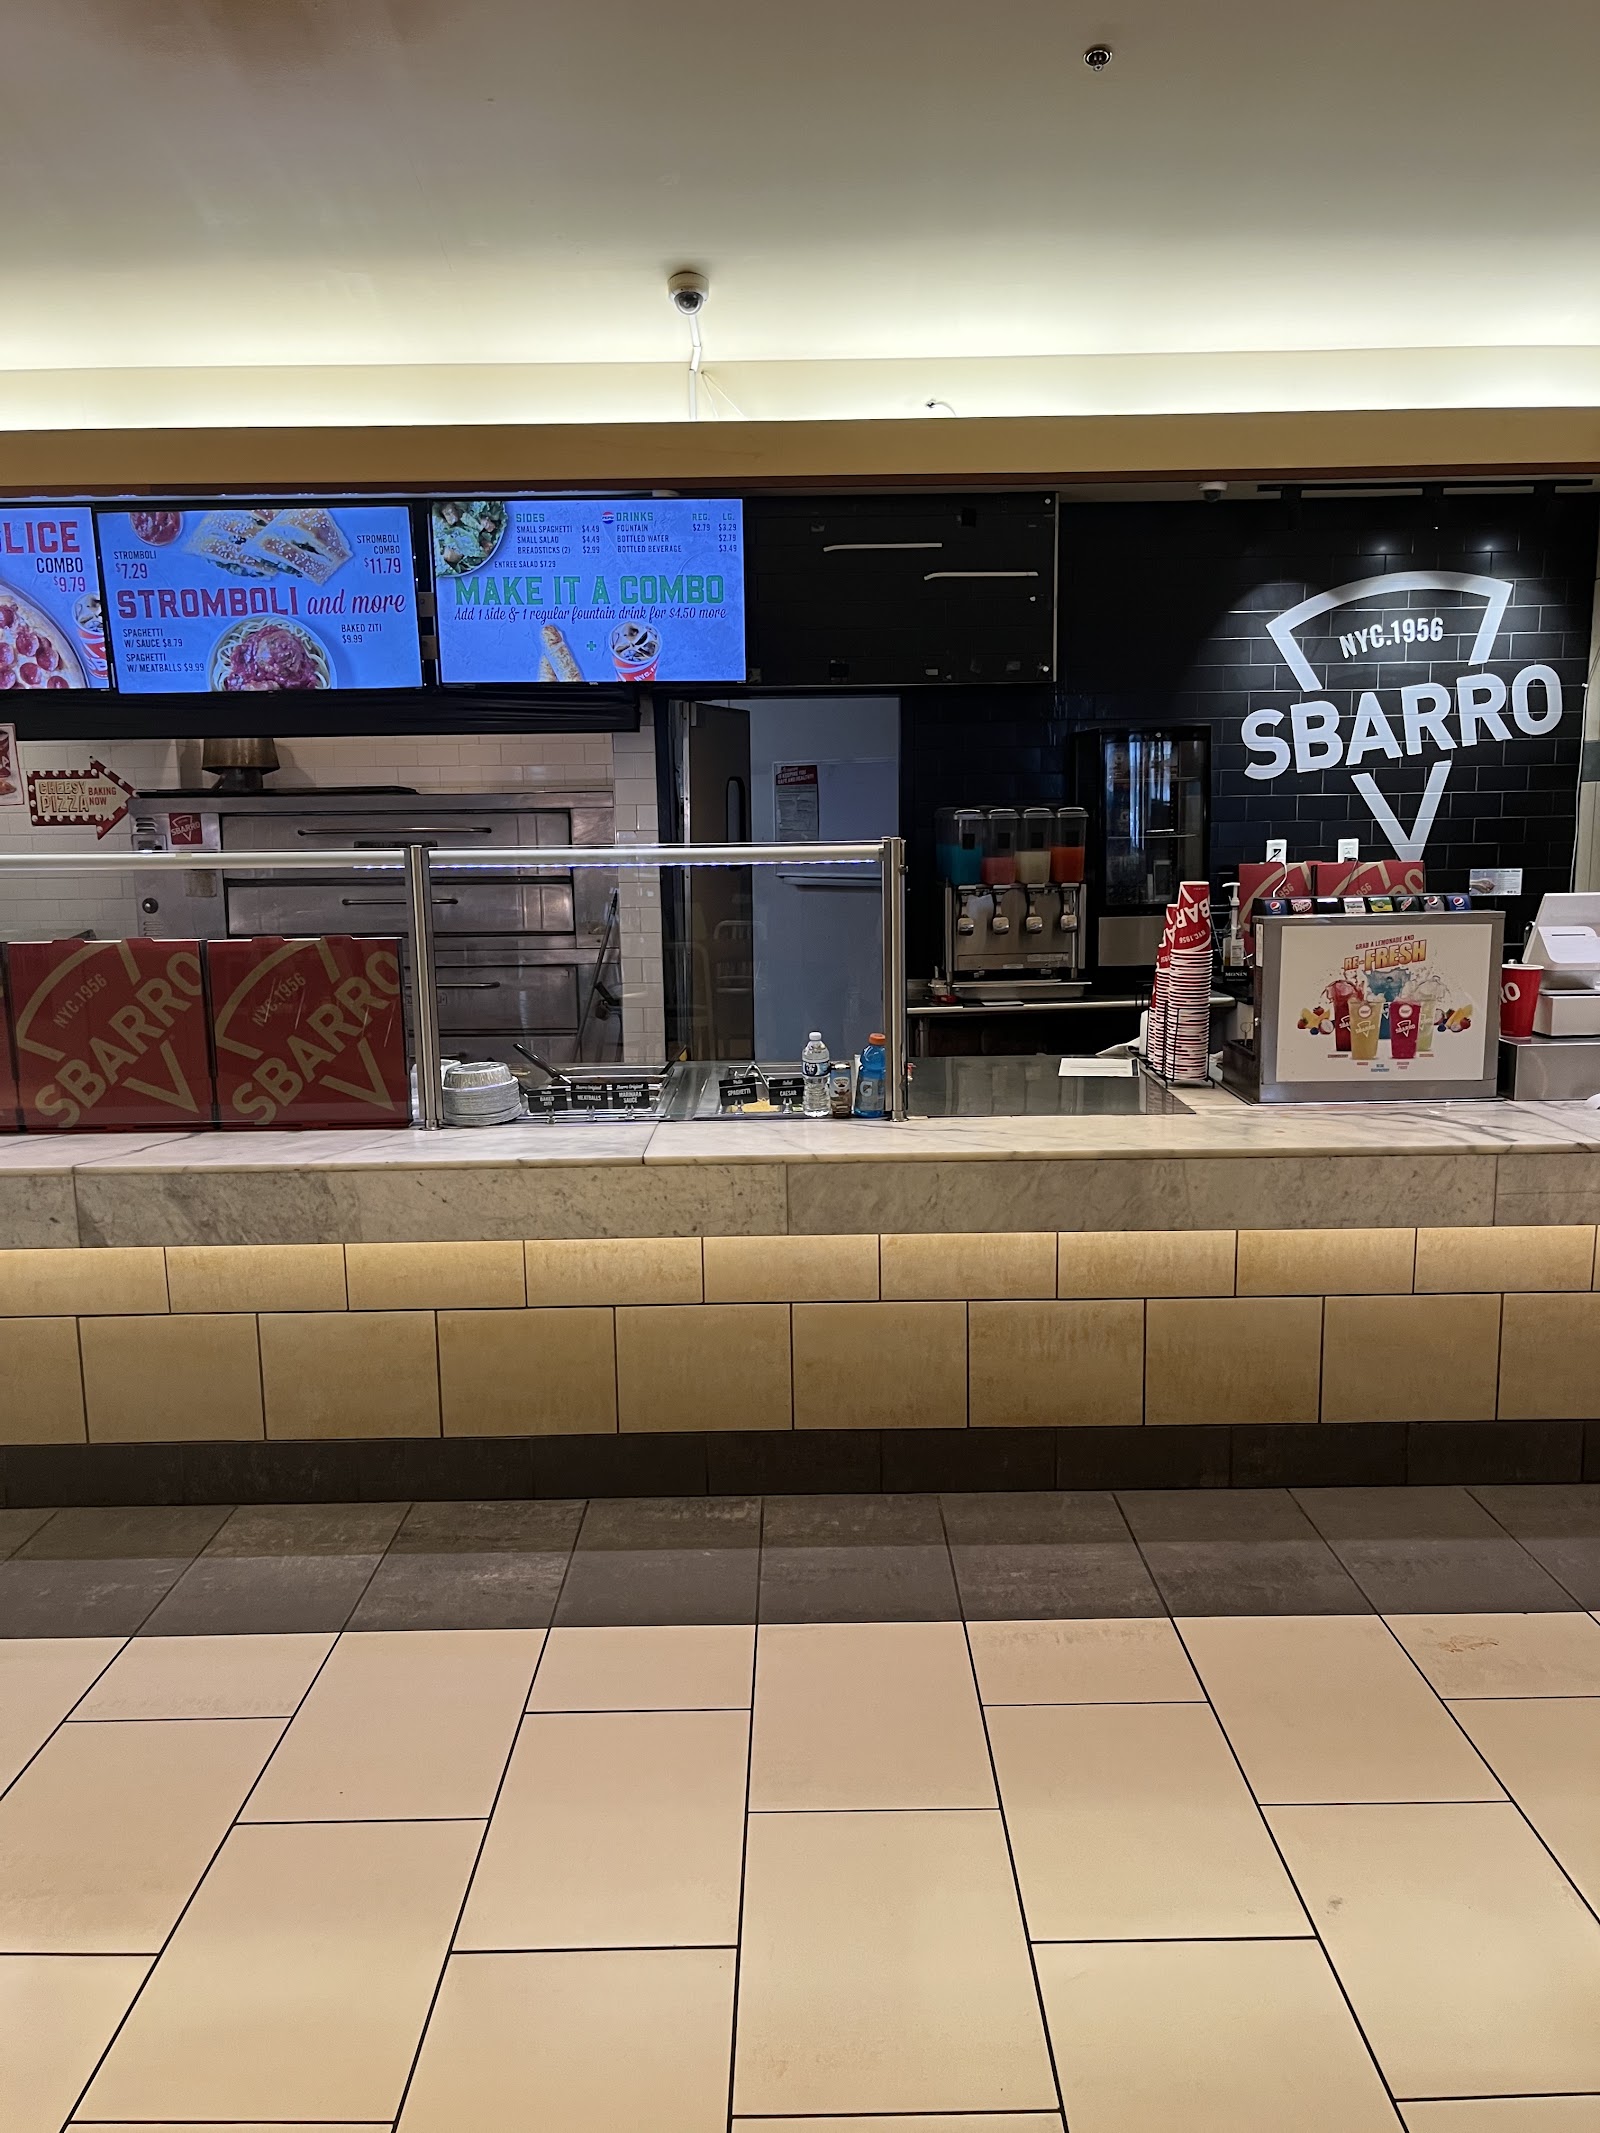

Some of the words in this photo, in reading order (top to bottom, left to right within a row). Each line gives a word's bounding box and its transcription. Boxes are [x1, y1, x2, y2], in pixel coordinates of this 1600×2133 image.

[516, 513, 545, 523] SIDES
[616, 511, 654, 522] DRINKS
[692, 513, 711, 521] REG.
[722, 512, 735, 521] LG.
[516, 525, 537, 534] SMALL
[538, 524, 573, 534] SPAGHETTI
[581, 524, 600, 534] $4.49
[616, 524, 649, 533] FOUNTAIN
[0, 521, 80, 554] LICE
[356, 534, 400, 545] STROMBOLI
[517, 535, 538, 544] SMALL
[539, 535, 559, 544] SALAD
[581, 535, 600, 544] $4.49
[616, 534, 646, 543] BOTTLED
[647, 534, 670, 543] WATER
[373, 545, 400, 555] COMBO
[517, 546, 560, 555] BREADSTICKS
[561, 546, 571, 555] (2)
[617, 545, 646, 553] BOTTLED
[647, 544, 682, 553] BEVERAGE
[718, 544, 737, 553] $3.49
[113, 550, 157, 561] STROMBOLI
[36, 557, 84, 574] COMBO
[363, 557, 401, 575] $11.79
[494, 560, 517, 569] ENTREE
[518, 560, 538, 569] SALAD
[115, 562, 148, 580] $7.29
[53, 575, 86, 593] $9.79
[454, 575, 544, 606] MAKE
[553, 575, 581, 605] IT
[591, 575, 610, 605] A
[619, 574, 724, 605] COMBO
[117, 586, 299, 620] STROMBOLI
[307, 588, 347, 615] and
[351, 594, 407, 614] more
[454, 606, 475, 621] Add
[478, 608, 483, 621] 1
[484, 606, 506, 621] side
[508, 606, 520, 624] &
[522, 608, 527, 620] 1
[529, 606, 569, 625] regular
[571, 605, 616, 625] fountain
[618, 605, 647, 620] drink
[648, 605, 667, 624] for
[669, 606, 696, 619] $4.50
[698, 607, 727, 619] more
[122, 628, 164, 638] SPAGHETTI
[341, 623, 366, 633] BAKED
[367, 622, 382, 633] ZITI
[123, 638, 135, 649] W/
[136, 639, 161, 649] SAUCE
[341, 634, 363, 644] $9.99
[1338, 616, 1444, 660] NYC.1956
[125, 652, 167, 663] SPAGHETTI
[126, 662, 138, 673] W/
[139, 662, 182, 673] MEATBALLS
[183, 662, 205, 672] $9.99
[1240, 663, 1564, 781] SBARRO
[38, 780, 88, 796] CHEESY
[88, 786, 117, 797] BAKING
[40, 795, 91, 813] PIZZA
[89, 796, 107, 806] NOW
[170, 821, 201, 837] SBARRO
[1375, 936, 1403, 947] LEMONADE
[52, 972, 108, 1030] NYC.1956
[251, 970, 308, 1029] NYC.1956
[35, 950, 201, 1130] SBARRO
[231, 949, 401, 1127] SBARRO
[727, 1088, 751, 1098] SPAGHETTI
[859, 1081, 873, 1097] G
[577, 1094, 602, 1102] MEATBALLS
